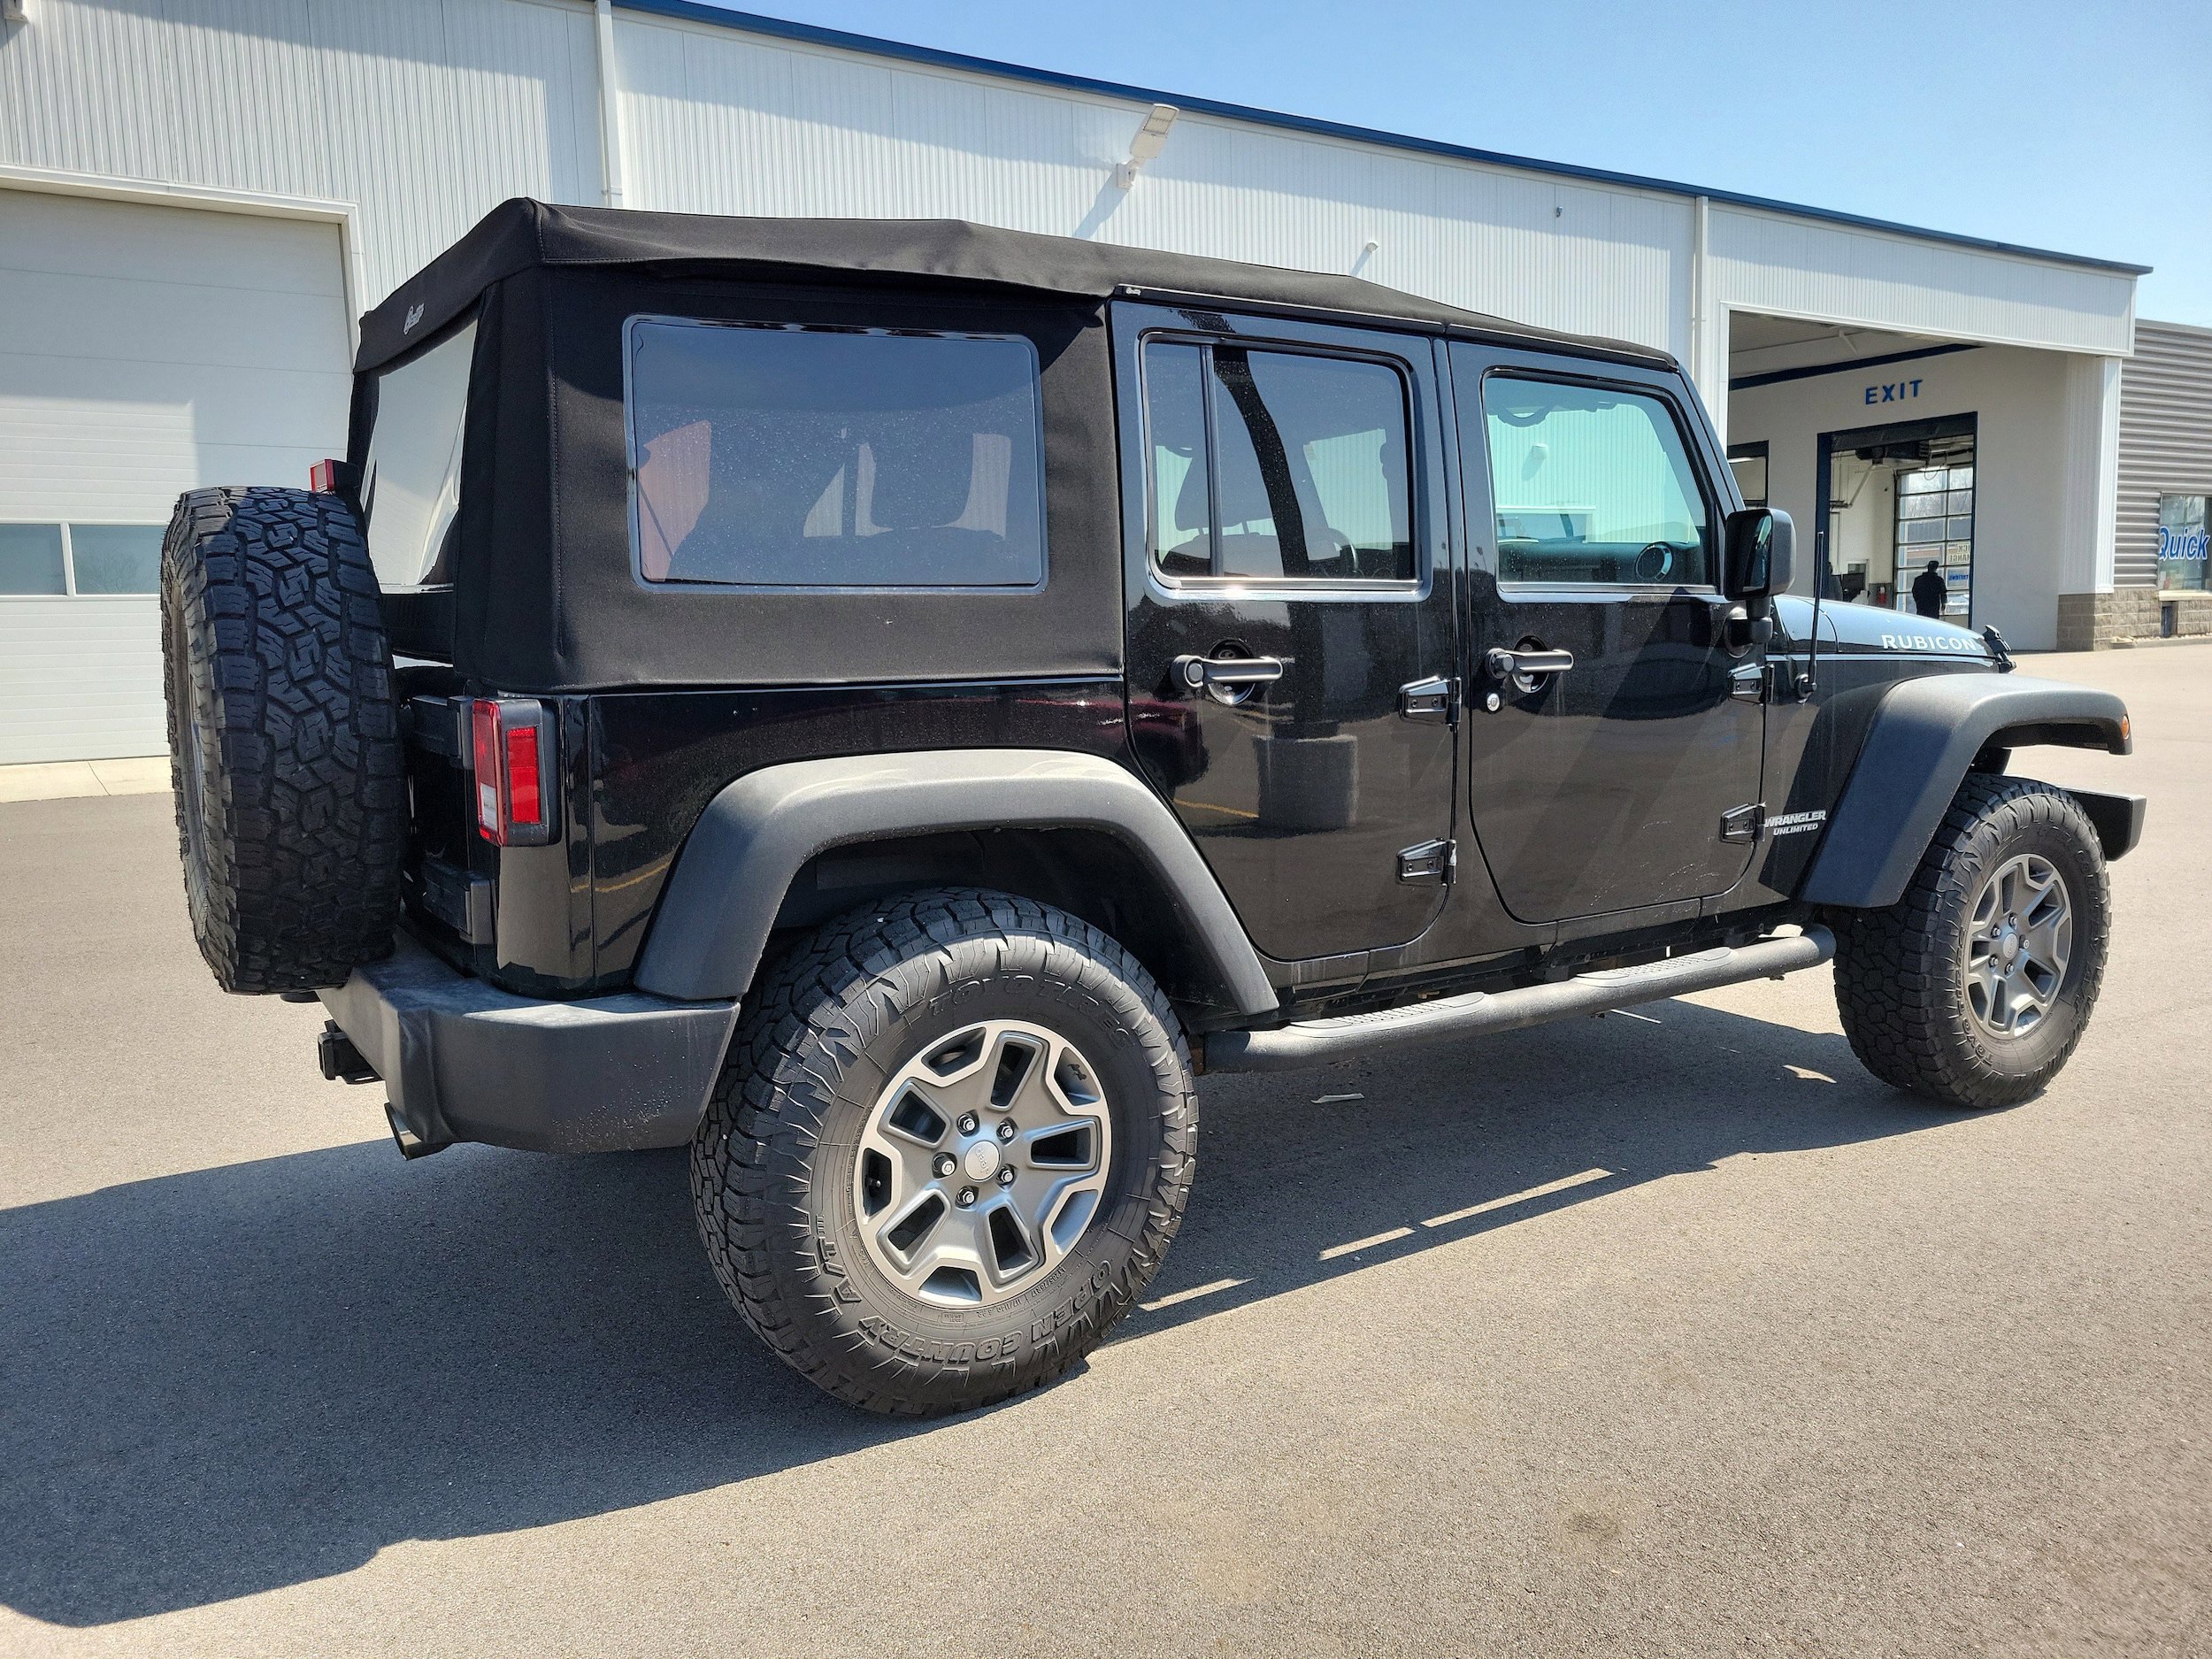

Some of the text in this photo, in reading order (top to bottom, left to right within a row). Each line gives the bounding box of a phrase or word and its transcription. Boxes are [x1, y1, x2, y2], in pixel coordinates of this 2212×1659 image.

[1865, 380, 1923, 404] EXIT
[2159, 526, 2210, 561] Quick
[1881, 634, 1977, 651] RUBICON
[1764, 810, 1826, 827] WRANGLER
[1773, 822, 1818, 835] UNLIMITED
[1031, 1260, 1112, 1343] OPEN
[857, 1315, 1023, 1365] COUNTRY
